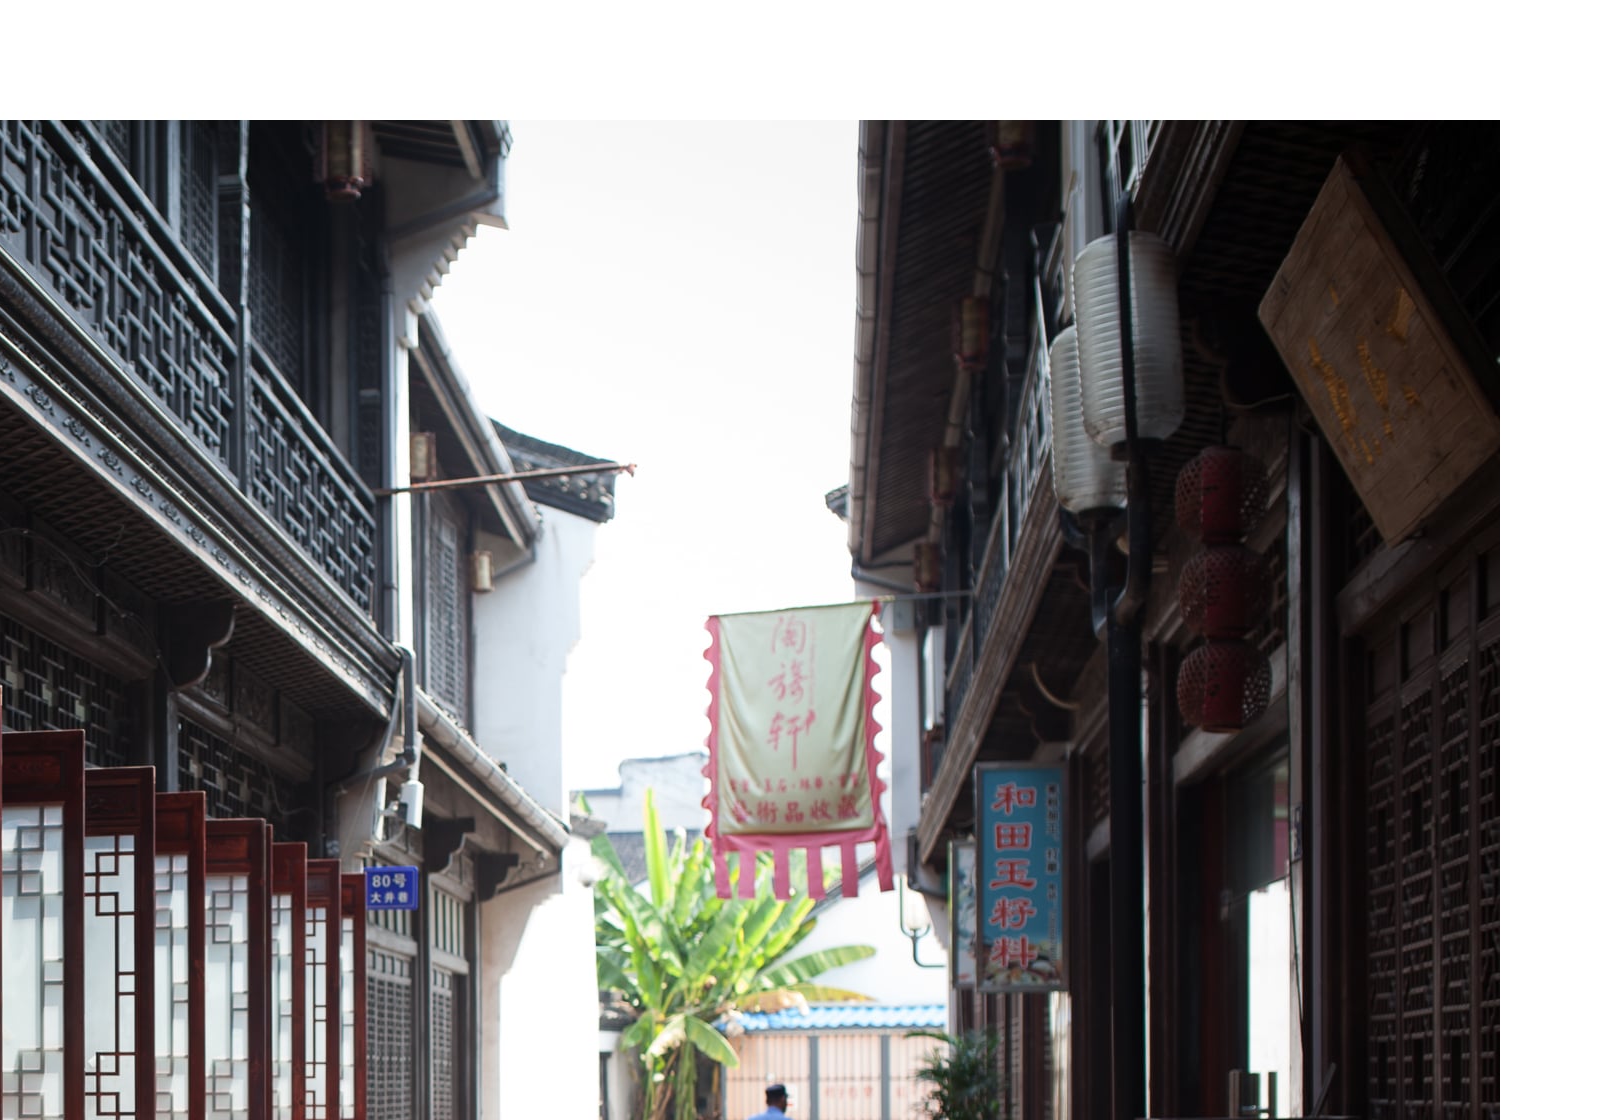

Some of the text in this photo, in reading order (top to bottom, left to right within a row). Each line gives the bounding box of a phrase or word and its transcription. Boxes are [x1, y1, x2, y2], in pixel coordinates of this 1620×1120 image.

[372, 873, 407, 888] 80号
[989, 781, 1037, 969] 和田玉籽料
